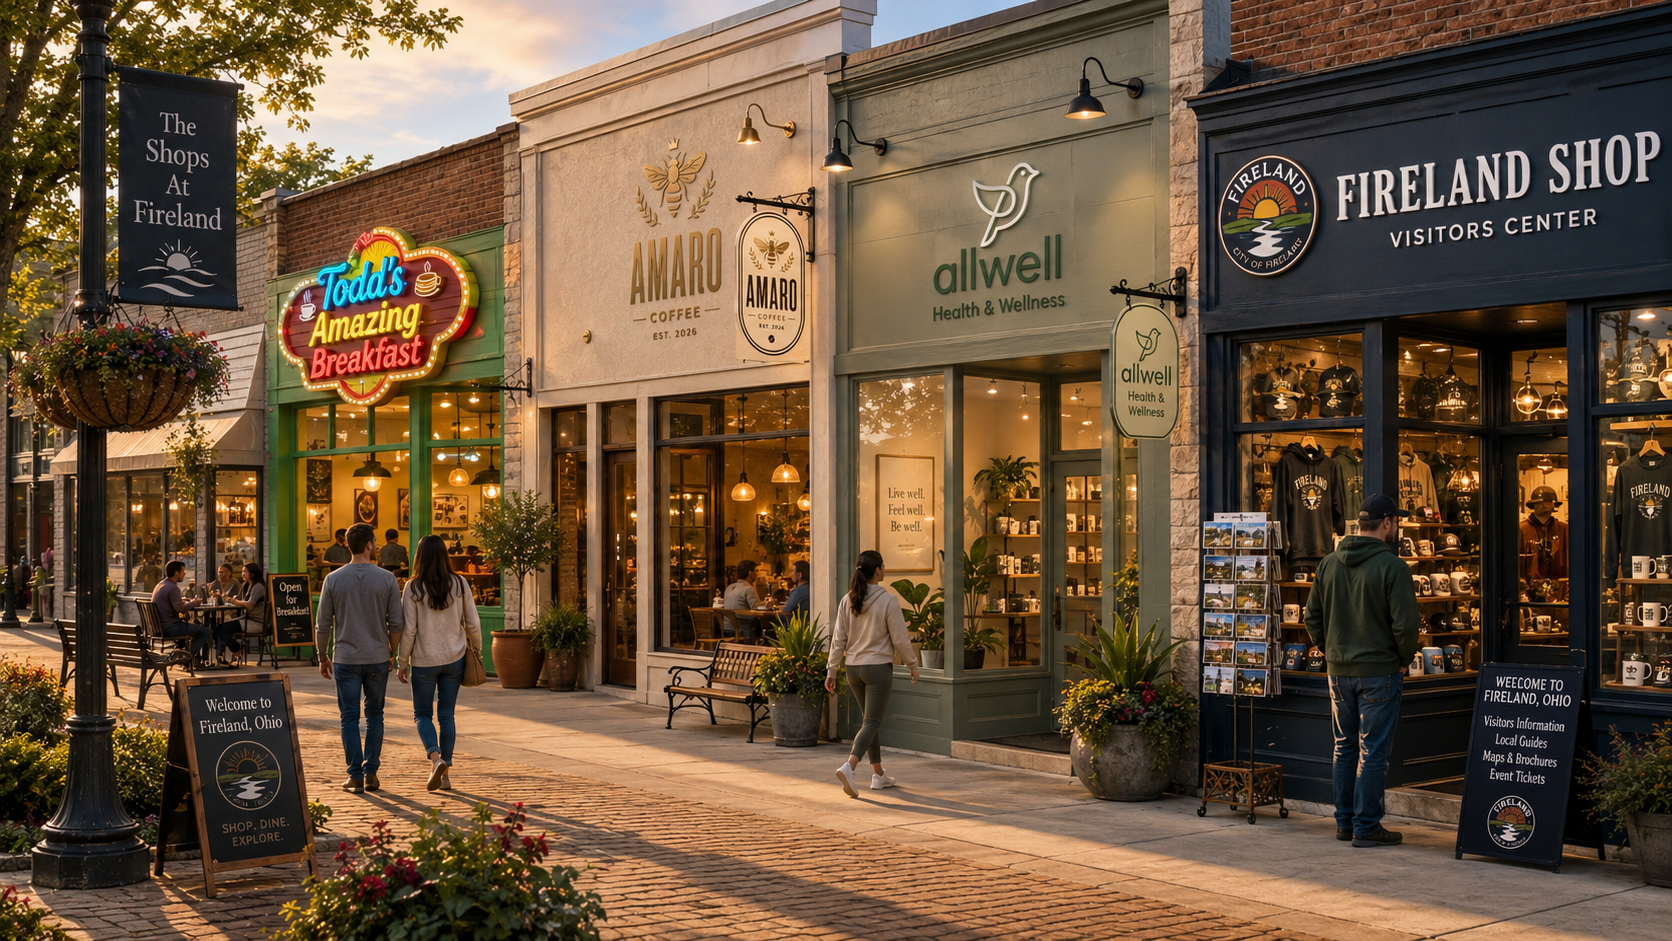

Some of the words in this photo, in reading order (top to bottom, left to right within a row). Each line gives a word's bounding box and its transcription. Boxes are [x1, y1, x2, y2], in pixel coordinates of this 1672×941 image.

[159, 111, 197, 136] The
[145, 138, 210, 174] Shops
[1227, 162, 1306, 204] FIRELAND
[1336, 150, 1531, 221] FIRELAND
[1549, 130, 1661, 194] SHOP
[165, 173, 190, 197] At
[133, 199, 222, 231] Fireland
[1390, 220, 1494, 248] VISITORS
[1504, 208, 1597, 235] CENTER
[630, 227, 722, 305] AMARO
[933, 233, 1062, 295] allwell
[1250, 260, 1263, 270] OF
[317, 256, 405, 311] Todd's
[746, 274, 797, 312] AMARO
[650, 305, 701, 323] COFFEE
[932, 301, 980, 322] Health
[983, 299, 995, 316] &
[998, 294, 1066, 314] Wellness
[308, 300, 423, 348] Amazing
[653, 329, 672, 341] EST.
[674, 327, 697, 339] 2026
[310, 334, 425, 379] Breakfast
[1121, 362, 1172, 387] allwell
[1127, 390, 1156, 403] Health
[1158, 392, 1165, 404] &
[1127, 405, 1165, 418] Wellness
[888, 487, 905, 499] Live
[907, 487, 925, 499] well.
[1630, 482, 1671, 498] FIRELAND
[888, 503, 905, 515] Feel
[907, 504, 925, 516] well.
[891, 520, 902, 532] Be
[903, 520, 922, 532] well.
[279, 581, 302, 595] Open
[1549, 679, 1564, 691] TO
[205, 696, 257, 713] Welcome
[259, 697, 272, 709] to
[1484, 689, 1539, 707] FIRELAND,
[1542, 693, 1572, 707] OHIO
[199, 716, 252, 735] Fireland,
[254, 714, 283, 730] Ohio
[1484, 715, 1514, 729] Visitors
[1516, 717, 1565, 733] Information
[1495, 733, 1518, 746] Local
[1519, 735, 1548, 749] Guides
[1482, 749, 1505, 766] Maps
[1506, 751, 1513, 764] &
[1515, 752, 1558, 768] Brochures
[1489, 767, 1513, 782] Event
[1516, 770, 1546, 785] Tickets
[222, 820, 257, 834] SHOP.
[259, 816, 290, 830] DINE.
[232, 831, 284, 847] EXPLORE.
